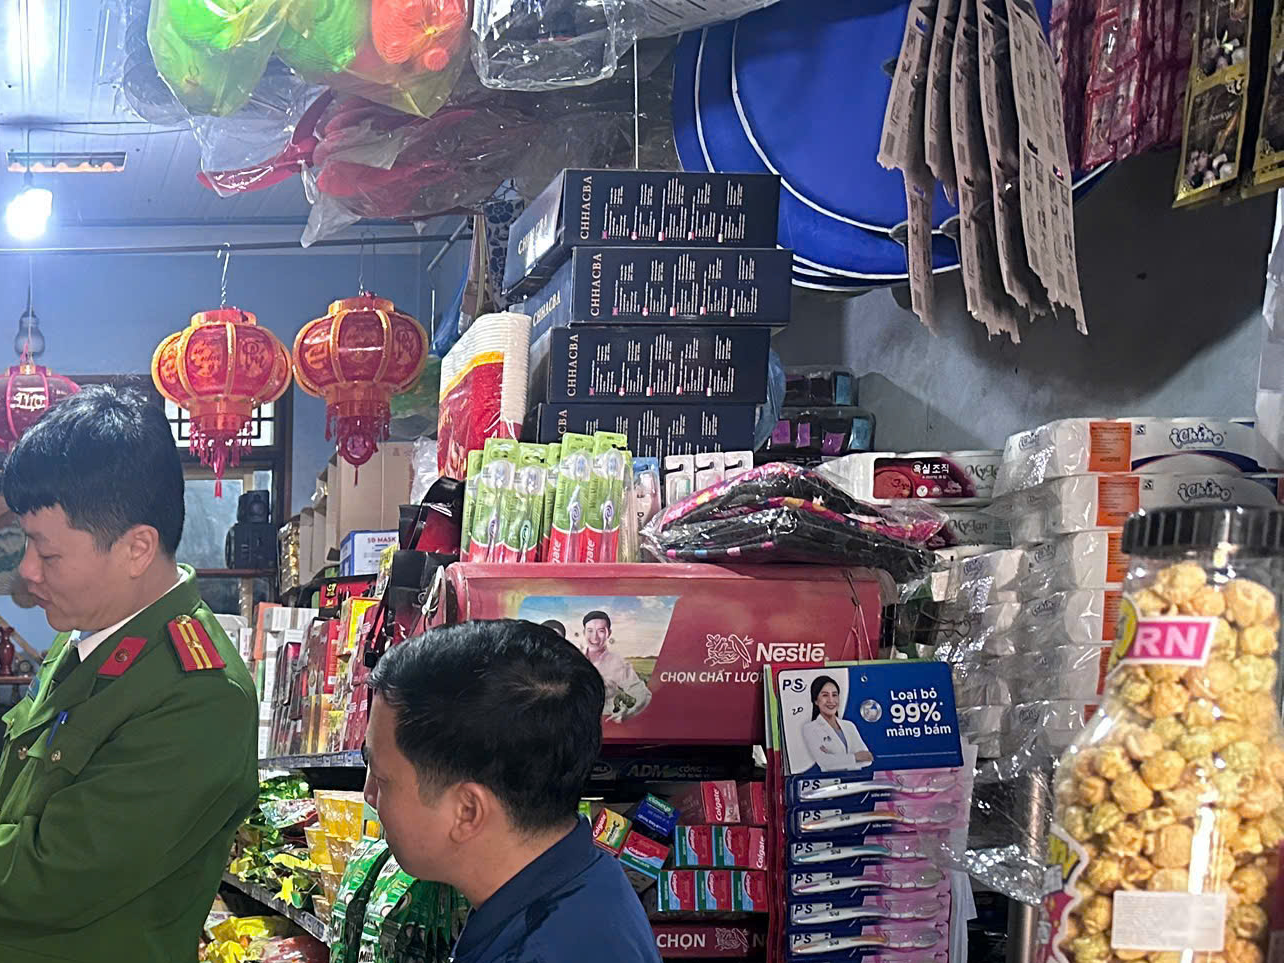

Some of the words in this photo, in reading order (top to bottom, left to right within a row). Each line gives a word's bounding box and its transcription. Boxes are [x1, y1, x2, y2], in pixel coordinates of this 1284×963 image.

[580, 175, 593, 240] CHHACBA
[590, 253, 603, 317] CHHACBA
[567, 333, 579, 397] CHHACBA
[552, 539, 561, 563] gate
[586, 539, 595, 563] gate
[756, 642, 826, 663] Nestlé
[660, 671, 696, 685] CHỌN
[699, 668, 732, 683] CHẤT
[734, 670, 764, 684] LƯỢ
[890, 689, 917, 704] Loại
[921, 687, 937, 700] bỏ
[886, 725, 921, 738] mảng
[924, 723, 952, 735] bám
[593, 814, 606, 838] Colgate
[756, 836, 766, 869] Colgate
[657, 933, 706, 951] CHỌN
